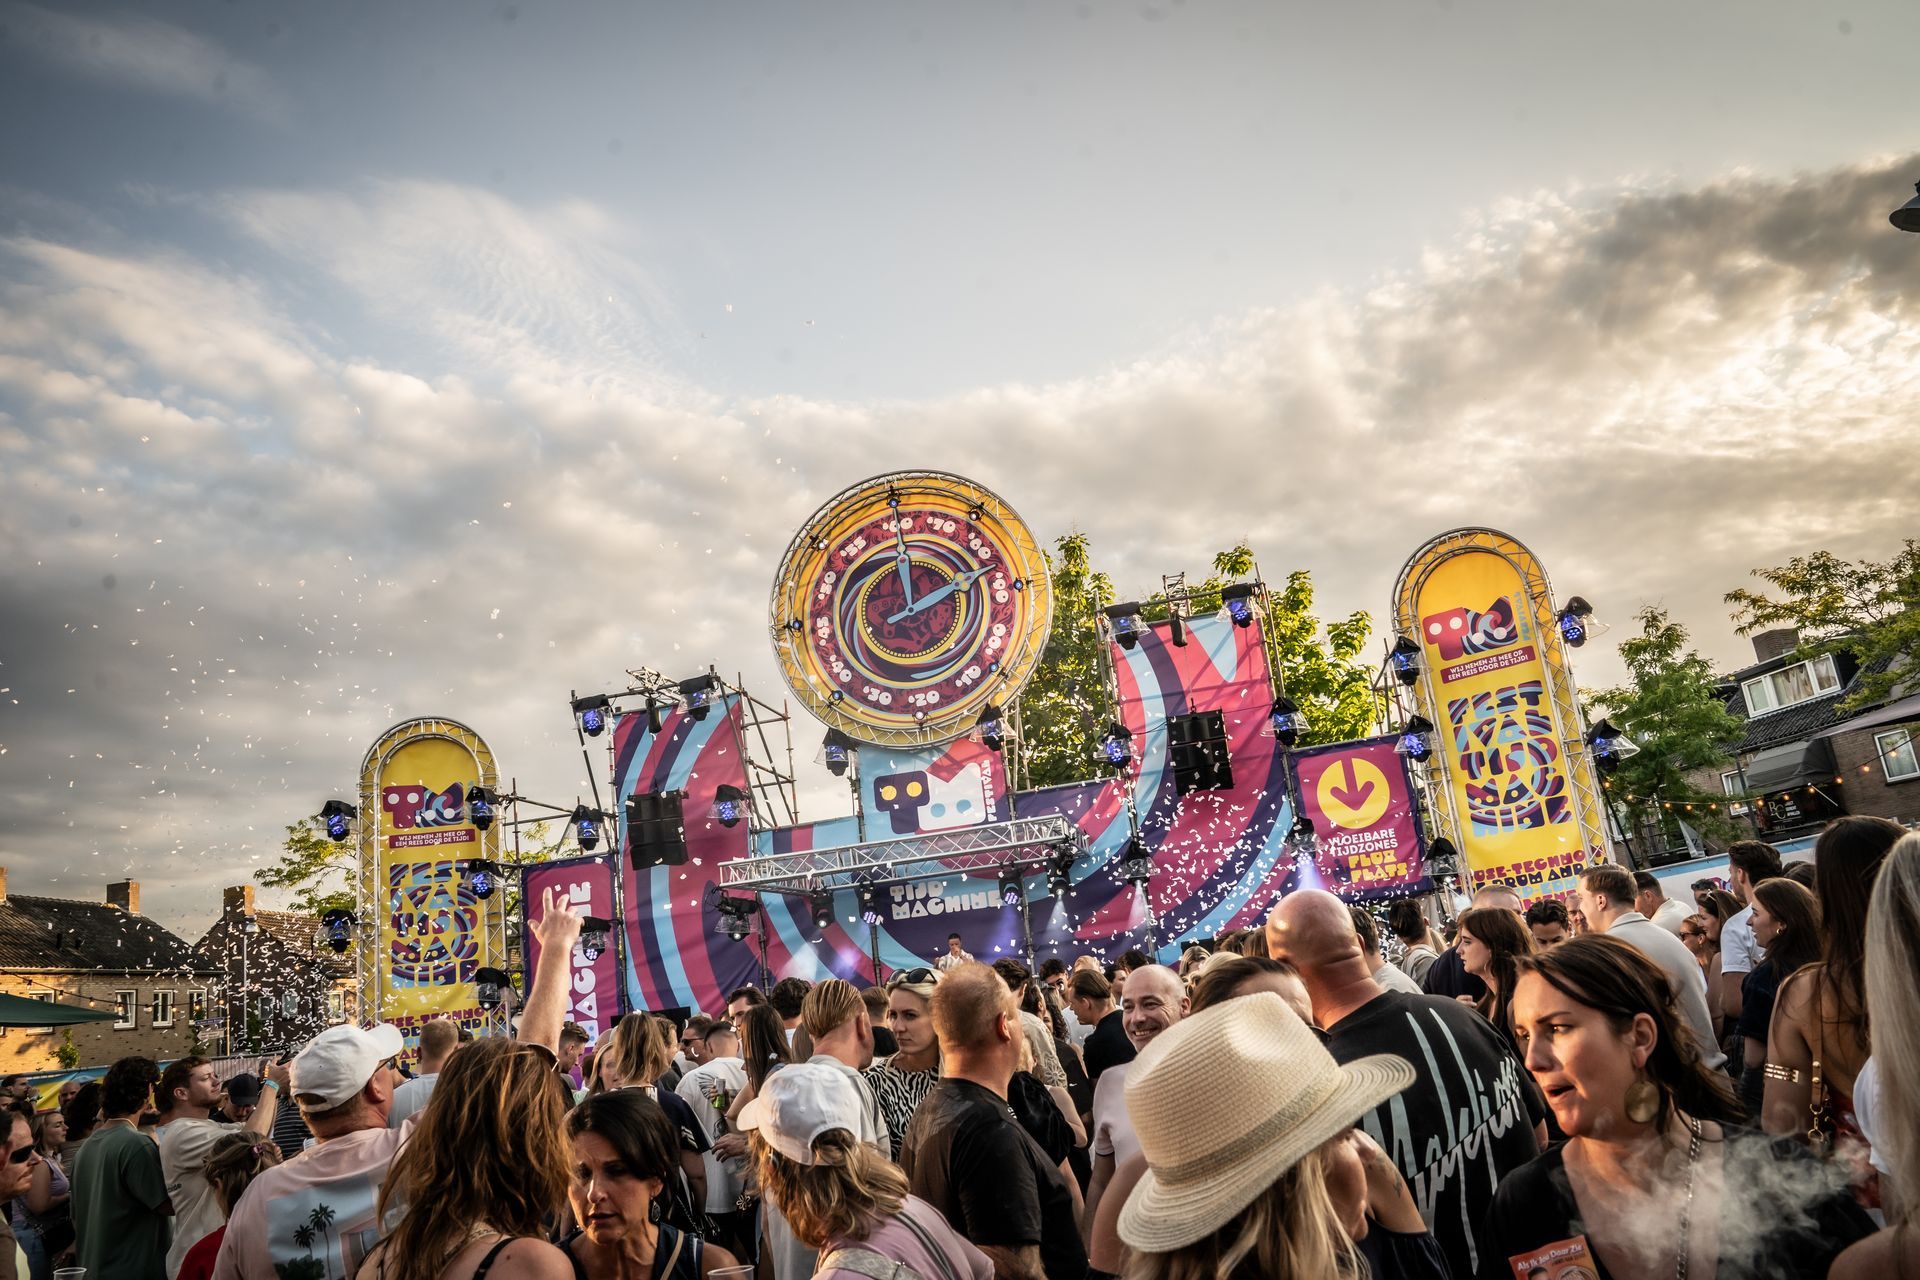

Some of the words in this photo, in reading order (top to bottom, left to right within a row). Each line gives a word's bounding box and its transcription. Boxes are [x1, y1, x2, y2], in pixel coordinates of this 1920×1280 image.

[1448, 672, 1461, 680] EEN
[1462, 667, 1478, 677] REIS
[1479, 662, 1499, 672] DOOR
[1500, 659, 1510, 667] DE
[1510, 655, 1528, 665] TIJD!
[1450, 664, 1464, 674] WIJ
[1465, 659, 1487, 670] NEMEN
[1488, 656, 1498, 664] JE
[1499, 653, 1512, 661] MEE
[1448, 680, 1544, 725] FEST
[1453, 709, 1553, 753] IVAL
[1460, 737, 1558, 781] TIJD
[980, 759, 997, 822] FESTIVAL
[1465, 766, 1565, 810] MAC
[1470, 795, 1573, 838] HINE
[1329, 839, 1398, 857] TIJDZONES
[1348, 850, 1397, 869] FLUX
[1350, 862, 1408, 883] FLATS
[1548, 863, 1584, 881] AND
[890, 880, 944, 902] TIJD
[891, 890, 1003, 920] MACHINE
[391, 907, 479, 938] TIJD
[391, 933, 479, 964] MAC
[1517, 1261, 1530, 1271] Als
[1550, 1247, 1569, 1259] Daar
